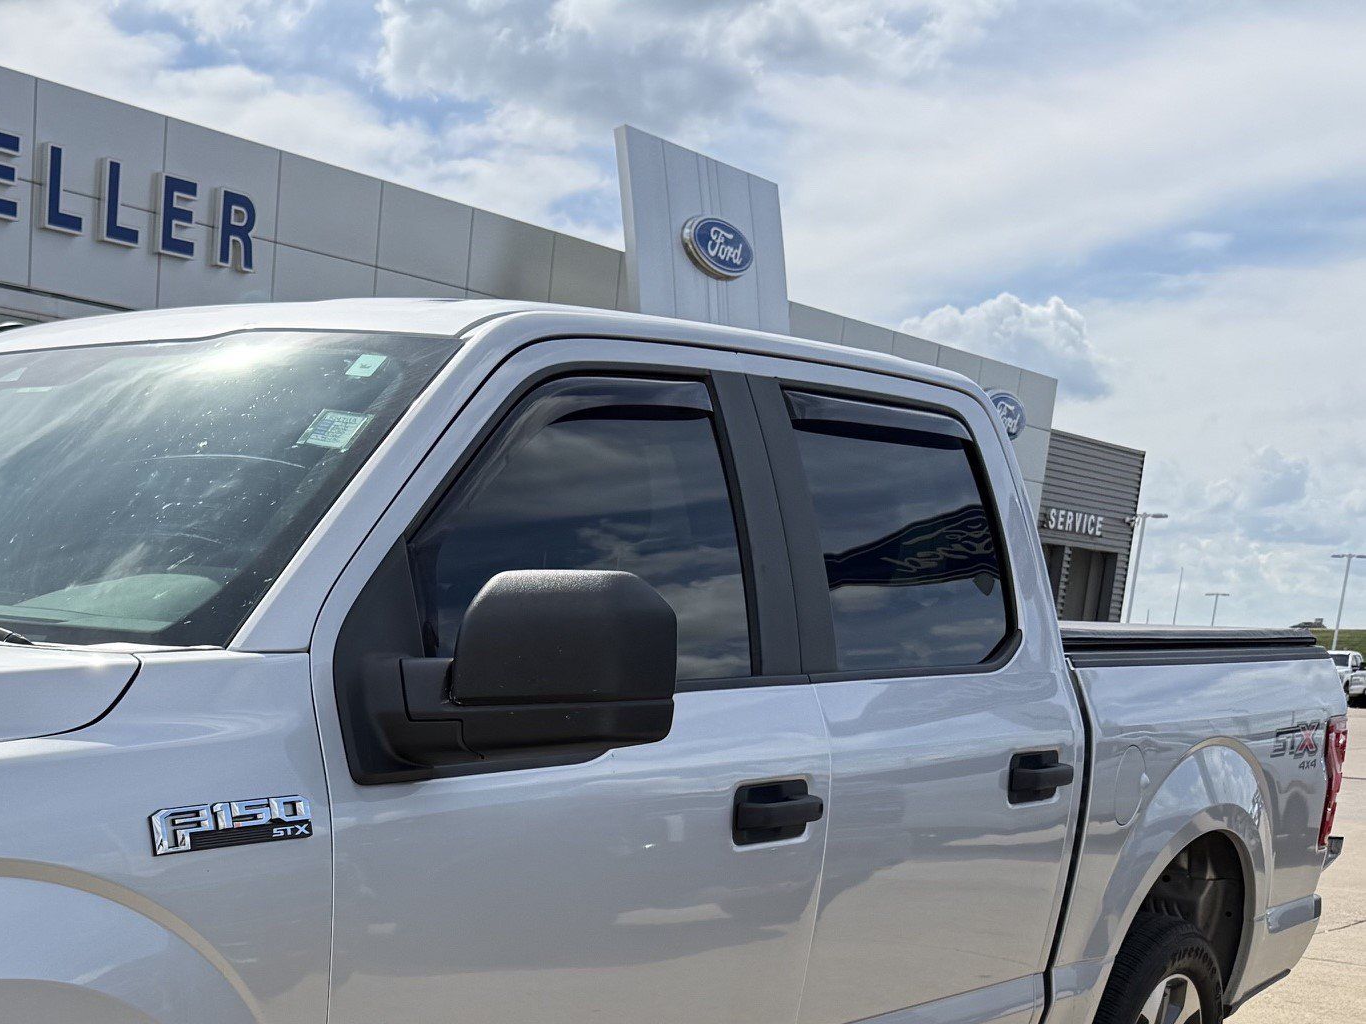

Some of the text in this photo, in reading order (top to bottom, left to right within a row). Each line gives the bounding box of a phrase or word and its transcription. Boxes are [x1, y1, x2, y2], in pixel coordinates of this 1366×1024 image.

[707, 226, 743, 265] Ford
[1048, 508, 1104, 536] SERVICE
[1270, 722, 1320, 759] STX
[272, 823, 310, 838] STX
